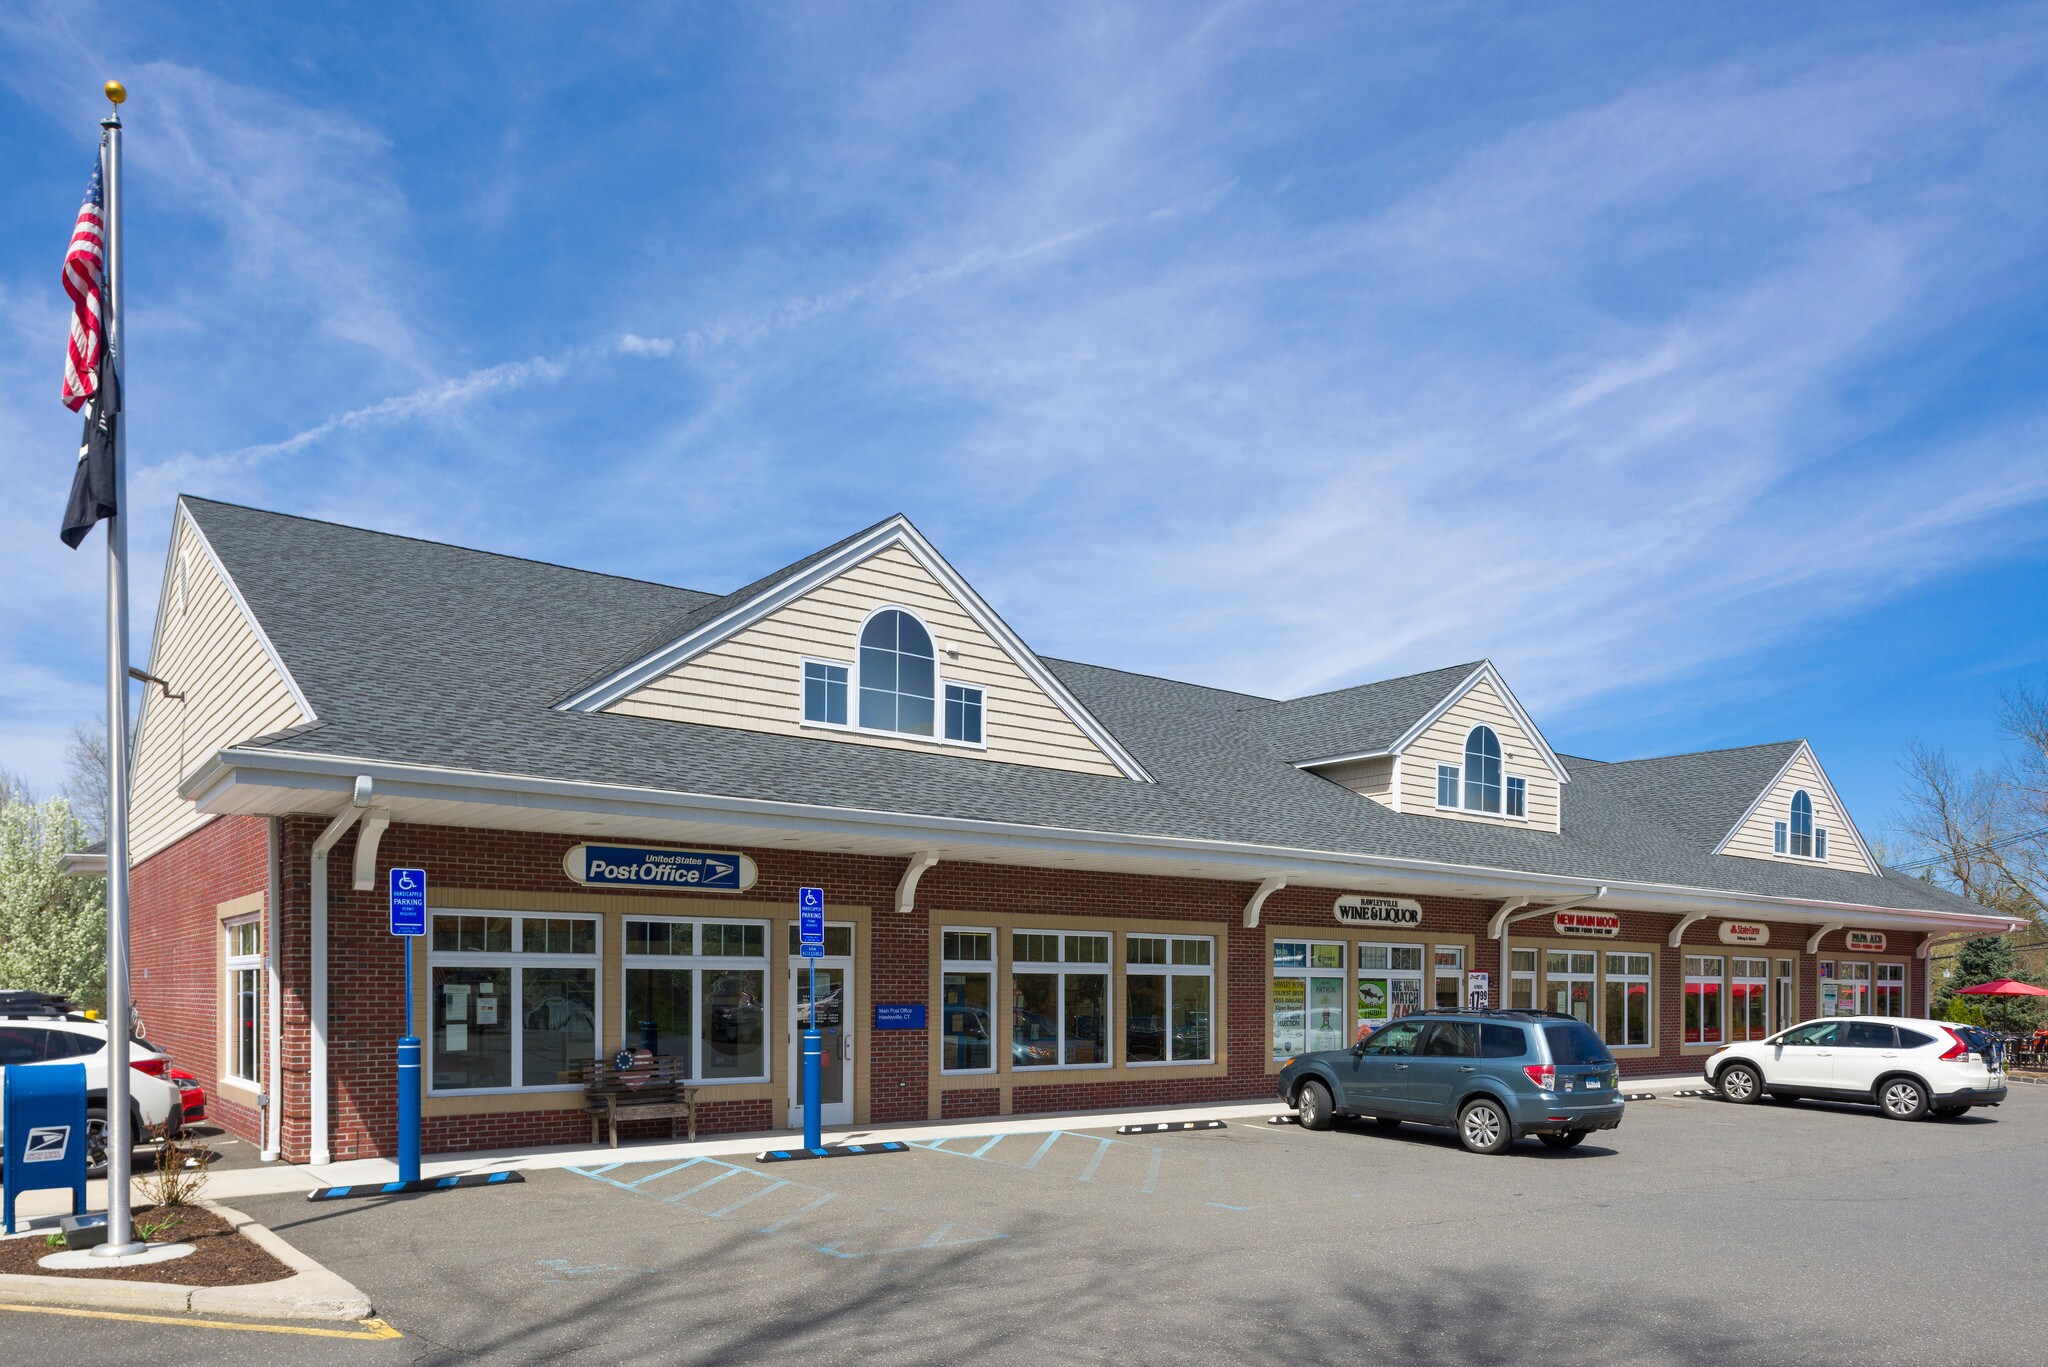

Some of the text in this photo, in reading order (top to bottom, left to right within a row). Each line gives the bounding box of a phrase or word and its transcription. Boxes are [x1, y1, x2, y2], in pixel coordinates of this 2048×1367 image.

[646, 854, 702, 865] United States
[589, 860, 700, 882] Post Office
[1361, 899, 1398, 907] HAWLEYVILLE
[1339, 906, 1418, 923] WINE & LIQUOR
[1557, 914, 1618, 928] NEW MAIN MOON
[1852, 933, 1868, 943] PAPA
[1392, 981, 1418, 991] WE WILL
[1392, 992, 1418, 1004] MATCH
[1392, 1004, 1418, 1020] ANY
